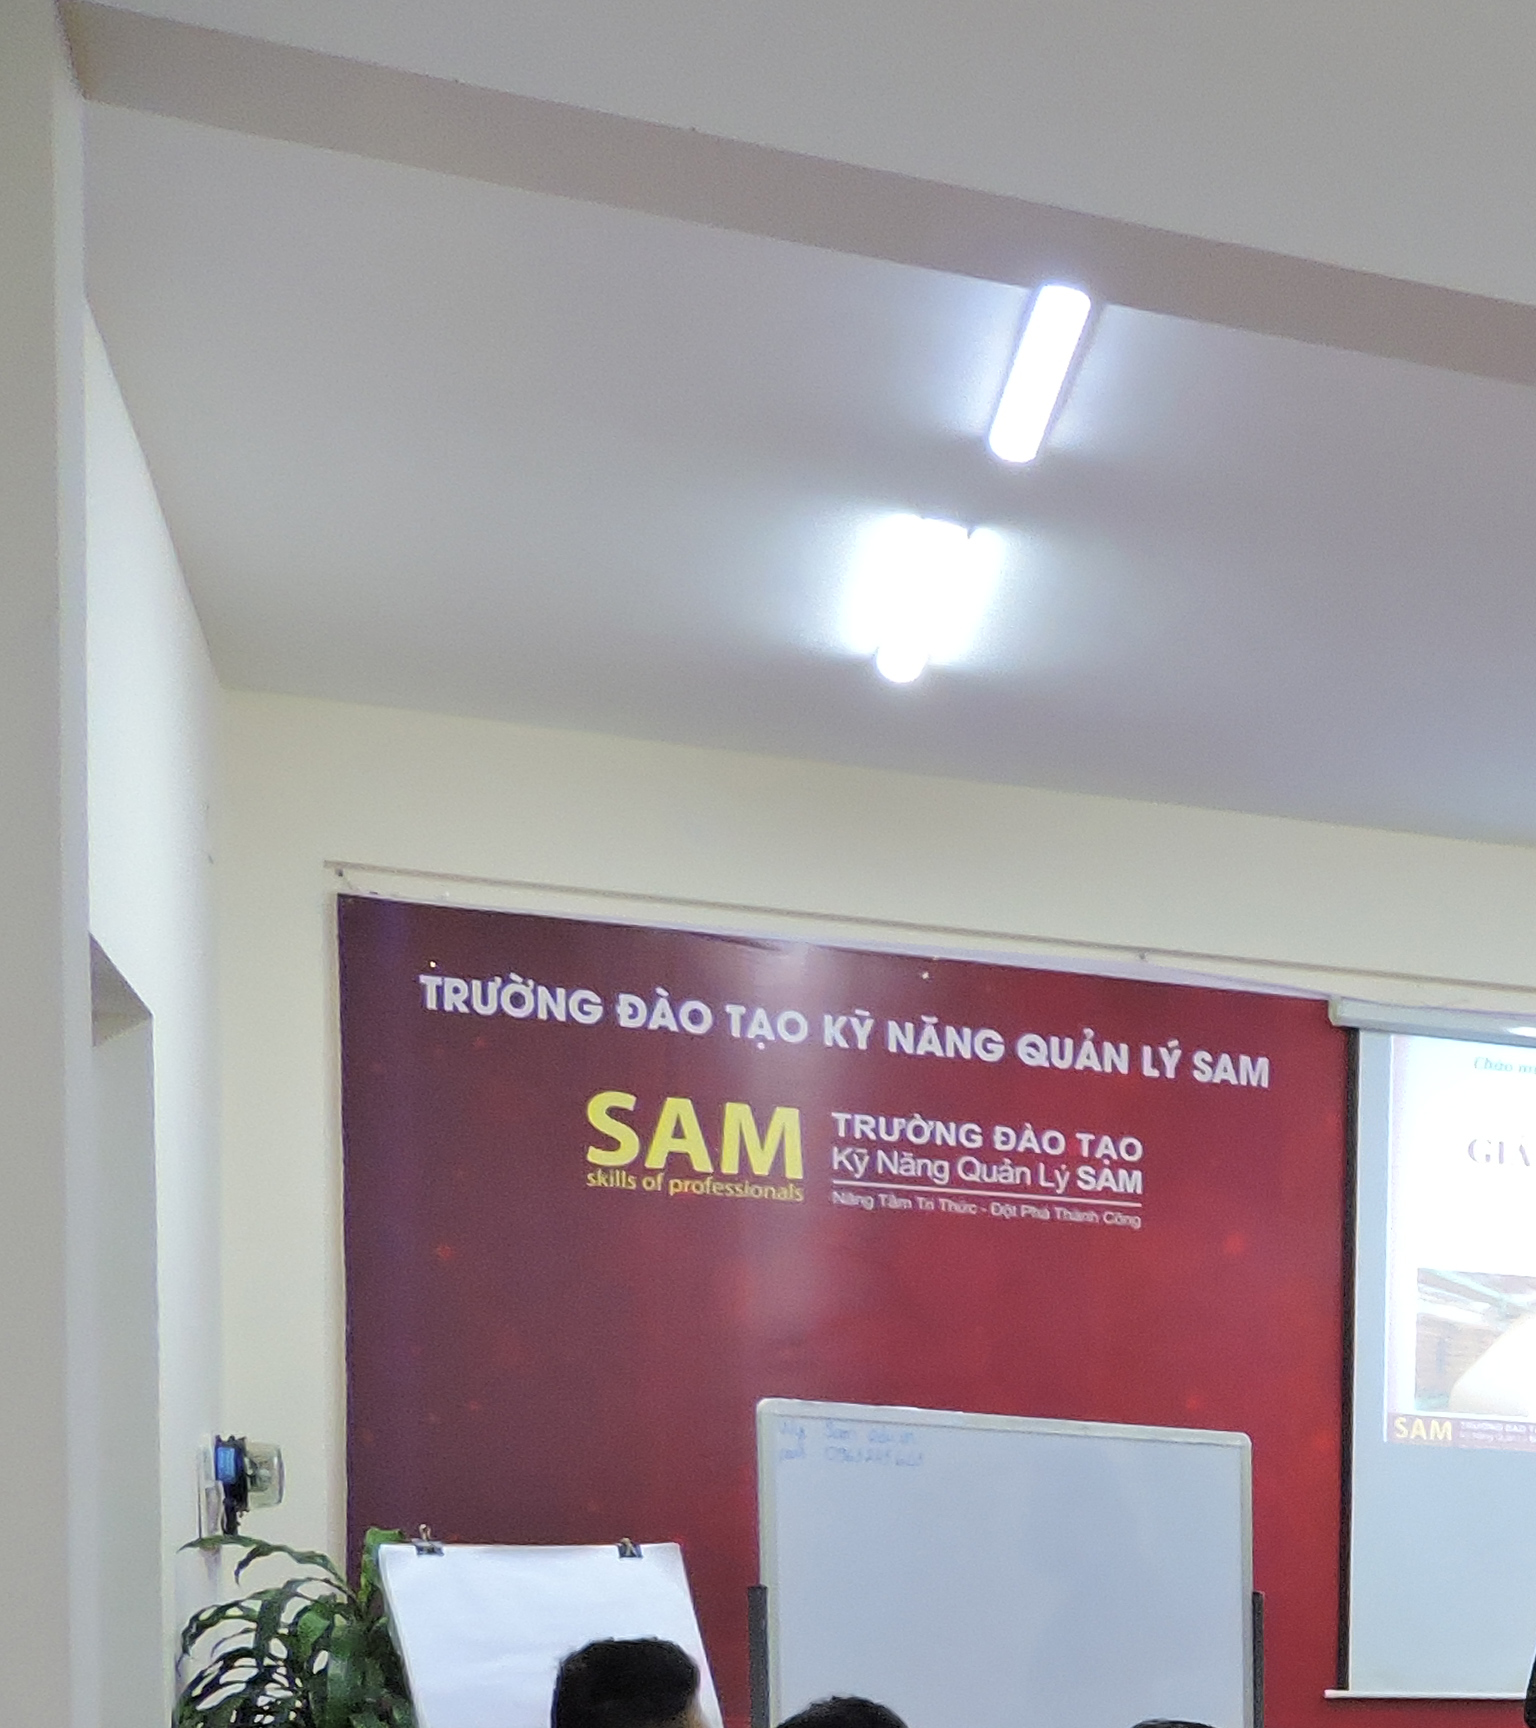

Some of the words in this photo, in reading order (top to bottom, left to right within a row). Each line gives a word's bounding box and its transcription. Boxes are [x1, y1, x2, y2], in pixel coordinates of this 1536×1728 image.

[419, 971, 603, 1025] TRƯỜNG
[617, 986, 713, 1036] ĐÀO
[725, 1003, 809, 1050] TẠO
[823, 1008, 875, 1052] KỸ
[886, 1014, 1005, 1063] NĂNG
[1017, 1028, 1130, 1075] QUẢN
[1142, 1039, 1183, 1079] LÝ
[1193, 1050, 1271, 1089] SAM
[587, 1091, 804, 1180] SAM
[831, 1112, 983, 1149] TRƯỜNG
[993, 1122, 1066, 1156] ĐÀO
[1075, 1132, 1144, 1166] TẠO
[586, 1169, 637, 1190] skills
[642, 1172, 665, 1192] of
[668, 1176, 804, 1202] professionals
[832, 1146, 869, 1179] Kỹ
[876, 1150, 950, 1185] Năng
[957, 1156, 1032, 1186] Quản
[1077, 1164, 1143, 1195] SAM
[1394, 1416, 1453, 1441] SAM
